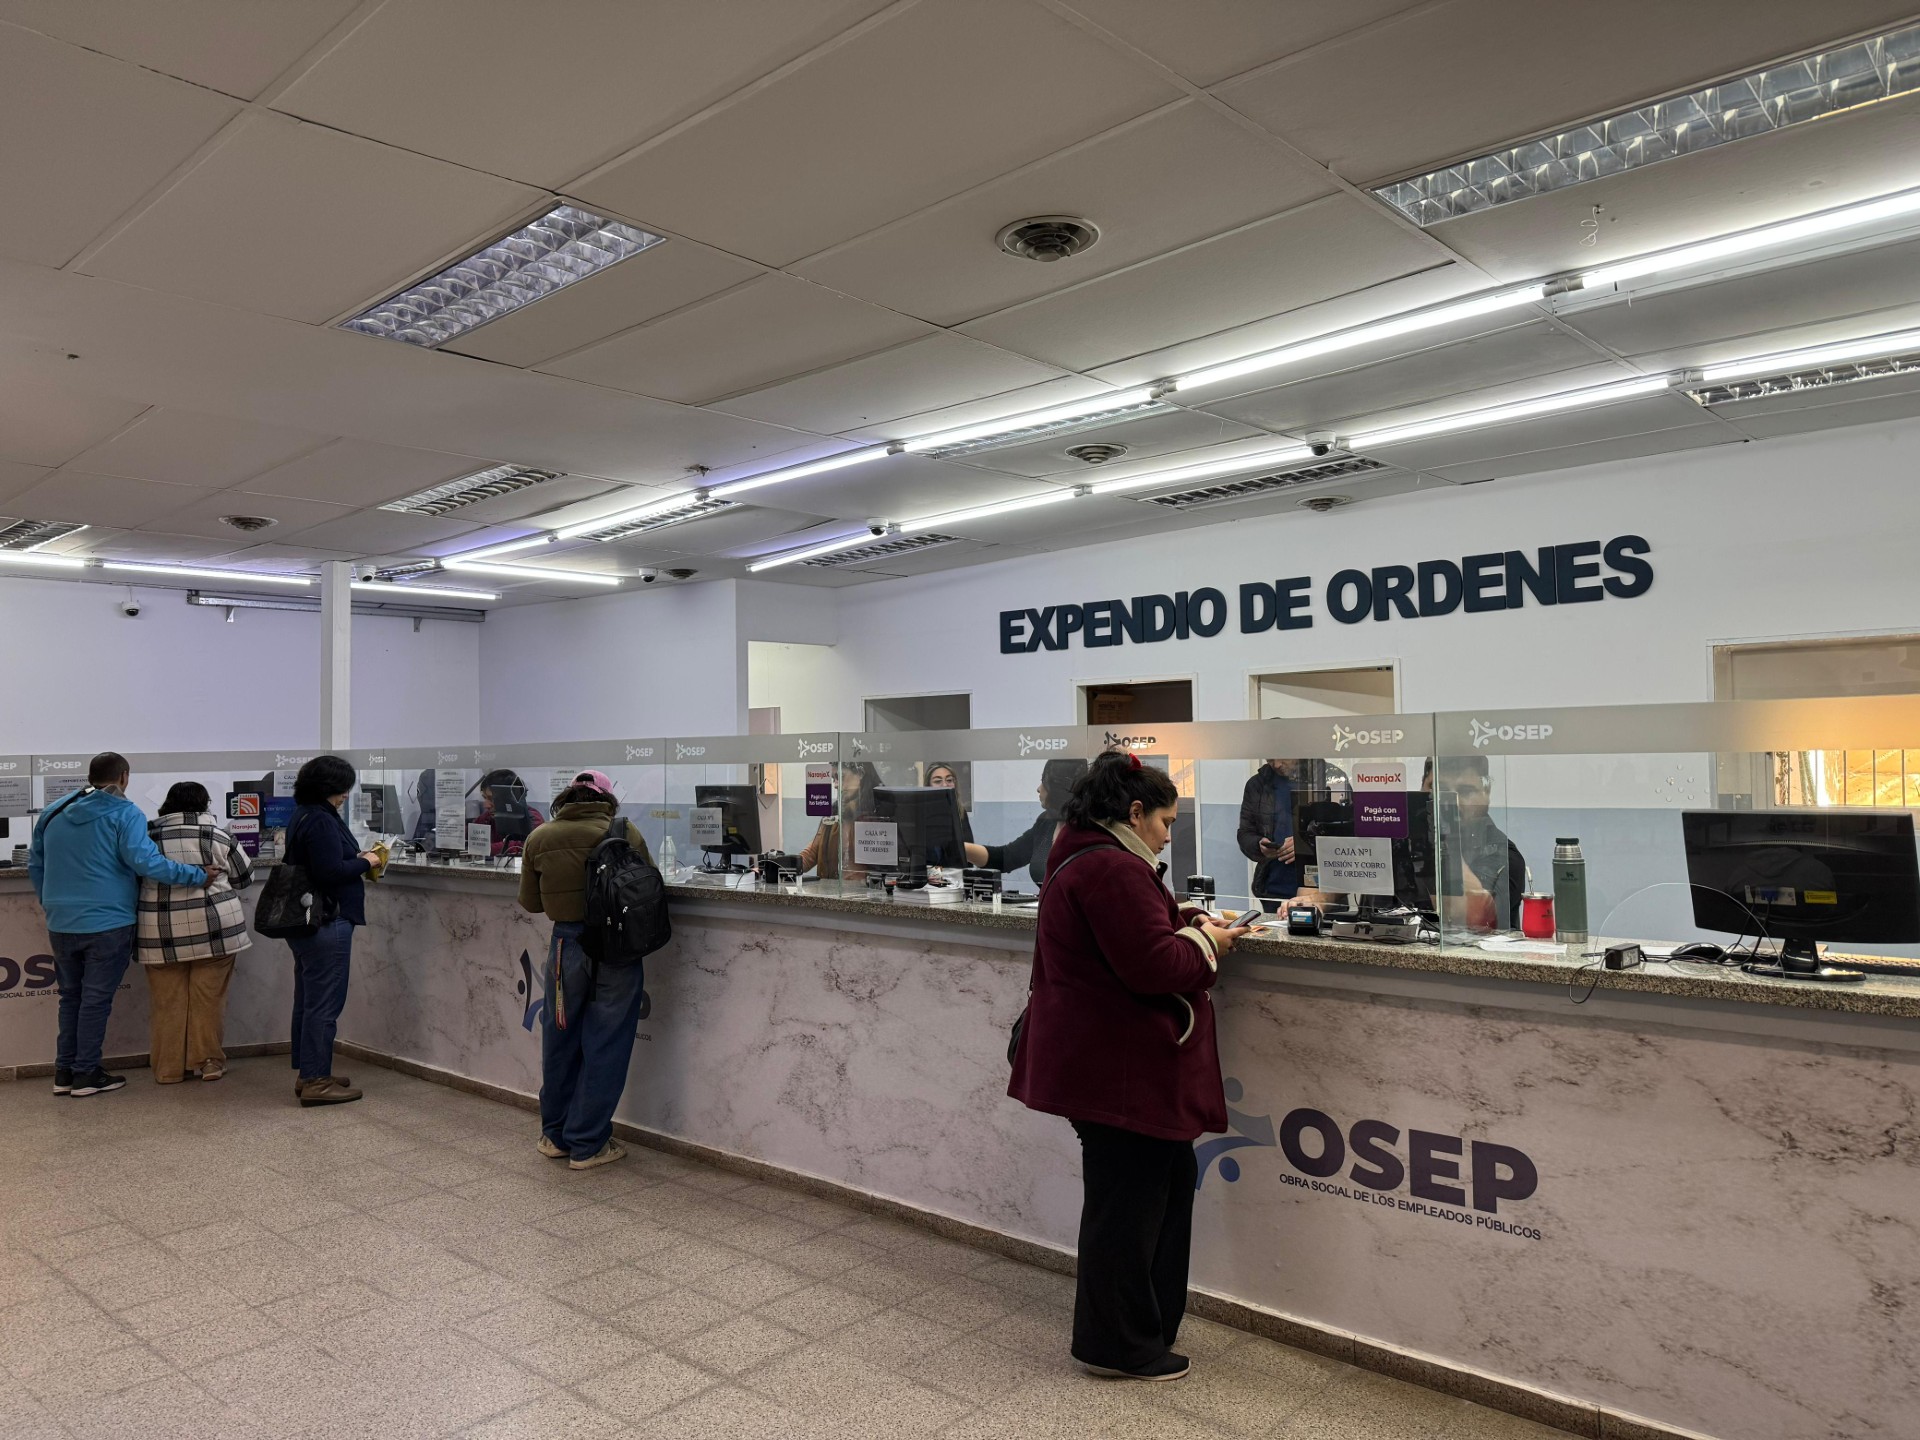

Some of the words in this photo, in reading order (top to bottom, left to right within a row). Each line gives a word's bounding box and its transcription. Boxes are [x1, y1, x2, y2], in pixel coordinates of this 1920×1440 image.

[999, 586, 1226, 654] EXPENDIO
[1239, 575, 1313, 634] DE
[1326, 534, 1654, 625] ORDENES
[1356, 729, 1404, 745] OSEP
[1497, 724, 1553, 741] OSEP
[1035, 738, 1068, 750] OSEP
[1121, 736, 1156, 749] OSEP
[635, 747, 654, 757] OSEP
[686, 746, 706, 756] OSEP
[810, 743, 834, 753] OSEP
[865, 743, 892, 753] OEP
[53, 761, 82, 769] OSEP
[807, 771, 830, 779] NaranjaX
[1357, 773, 1401, 785] NaranjaX
[1364, 806, 1382, 815] Pagá
[1373, 815, 1401, 823] tarjetas
[231, 823, 257, 831] NaranjaX
[1334, 848, 1357, 856] CAJA
[1324, 860, 1352, 868] EMISIÓN
[1360, 862, 1386, 870] COBRO
[1344, 870, 1377, 878] ORDENES
[0, 954, 58, 992] OS
[1279, 1107, 1539, 1214] OSEP
[1279, 1173, 1310, 1189] OBRA
[1311, 1180, 1351, 1199] SOCIAL
[1354, 1190, 1370, 1203] DE
[1372, 1193, 1396, 1208] LOS
[1398, 1200, 1473, 1226] EMPLEADOS
[1476, 1215, 1542, 1241] PÚBLICOS
